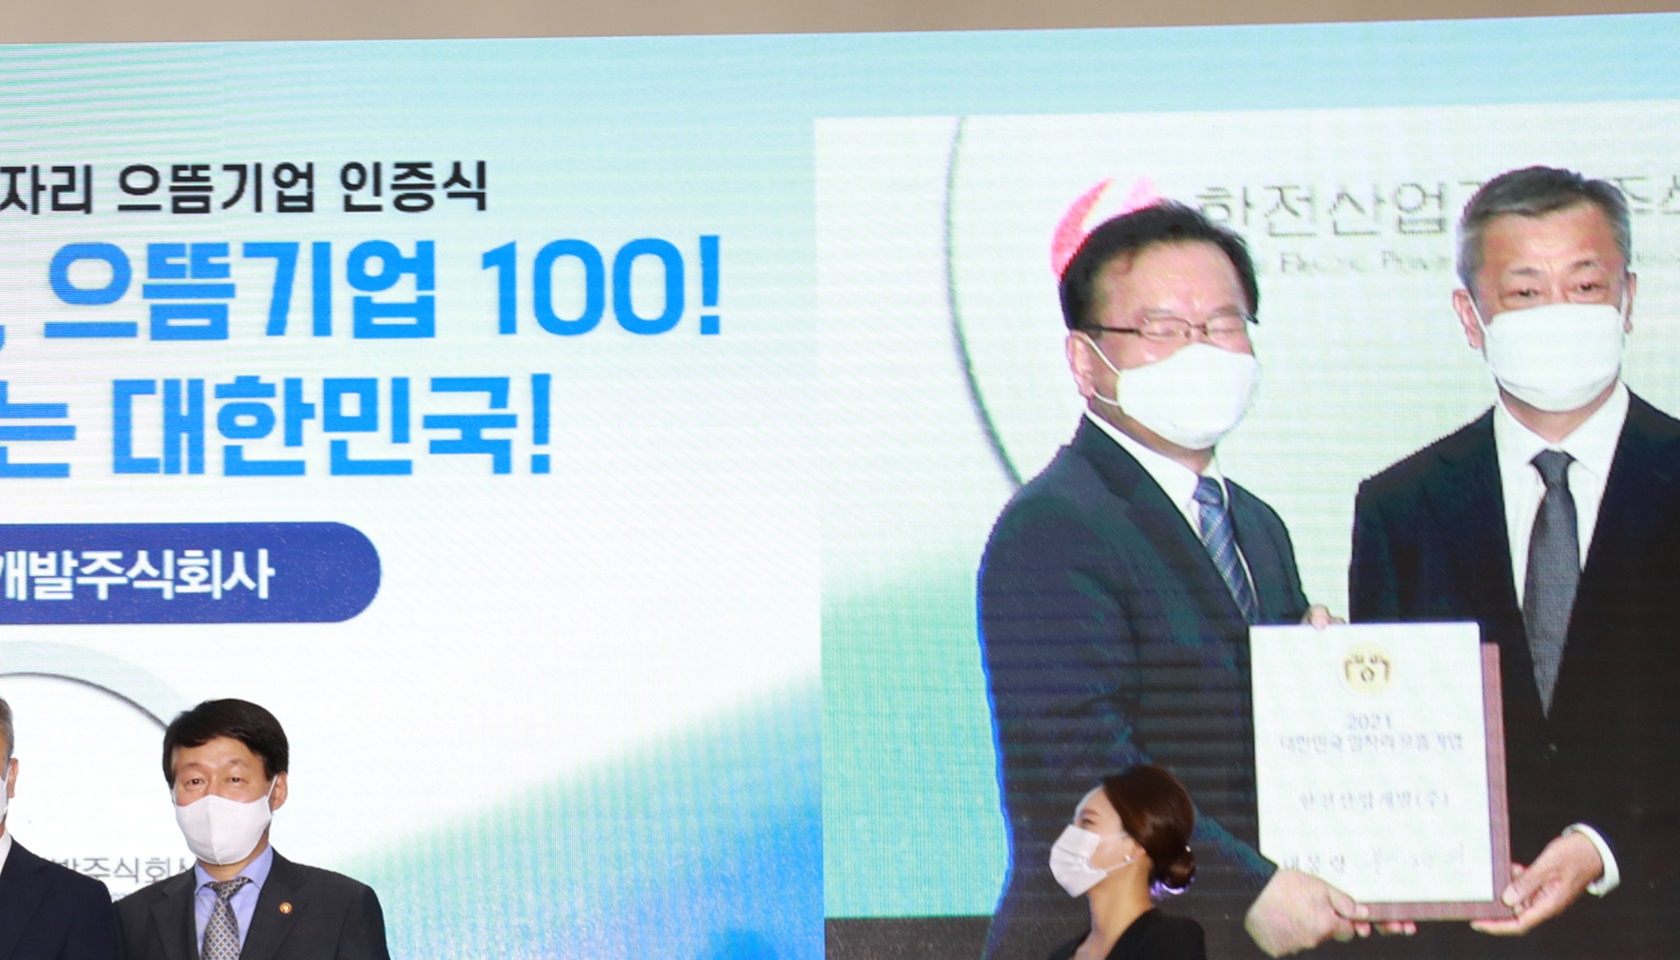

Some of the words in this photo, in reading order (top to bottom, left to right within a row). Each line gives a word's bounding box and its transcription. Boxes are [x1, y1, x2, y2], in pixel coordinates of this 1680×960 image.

[117, 163, 316, 216] 으뜸기업
[340, 161, 488, 213] 인증식
[44, 240, 437, 342] 으뜸기업
[481, 235, 722, 337] 100!
[112, 374, 553, 478] 대한민국!
